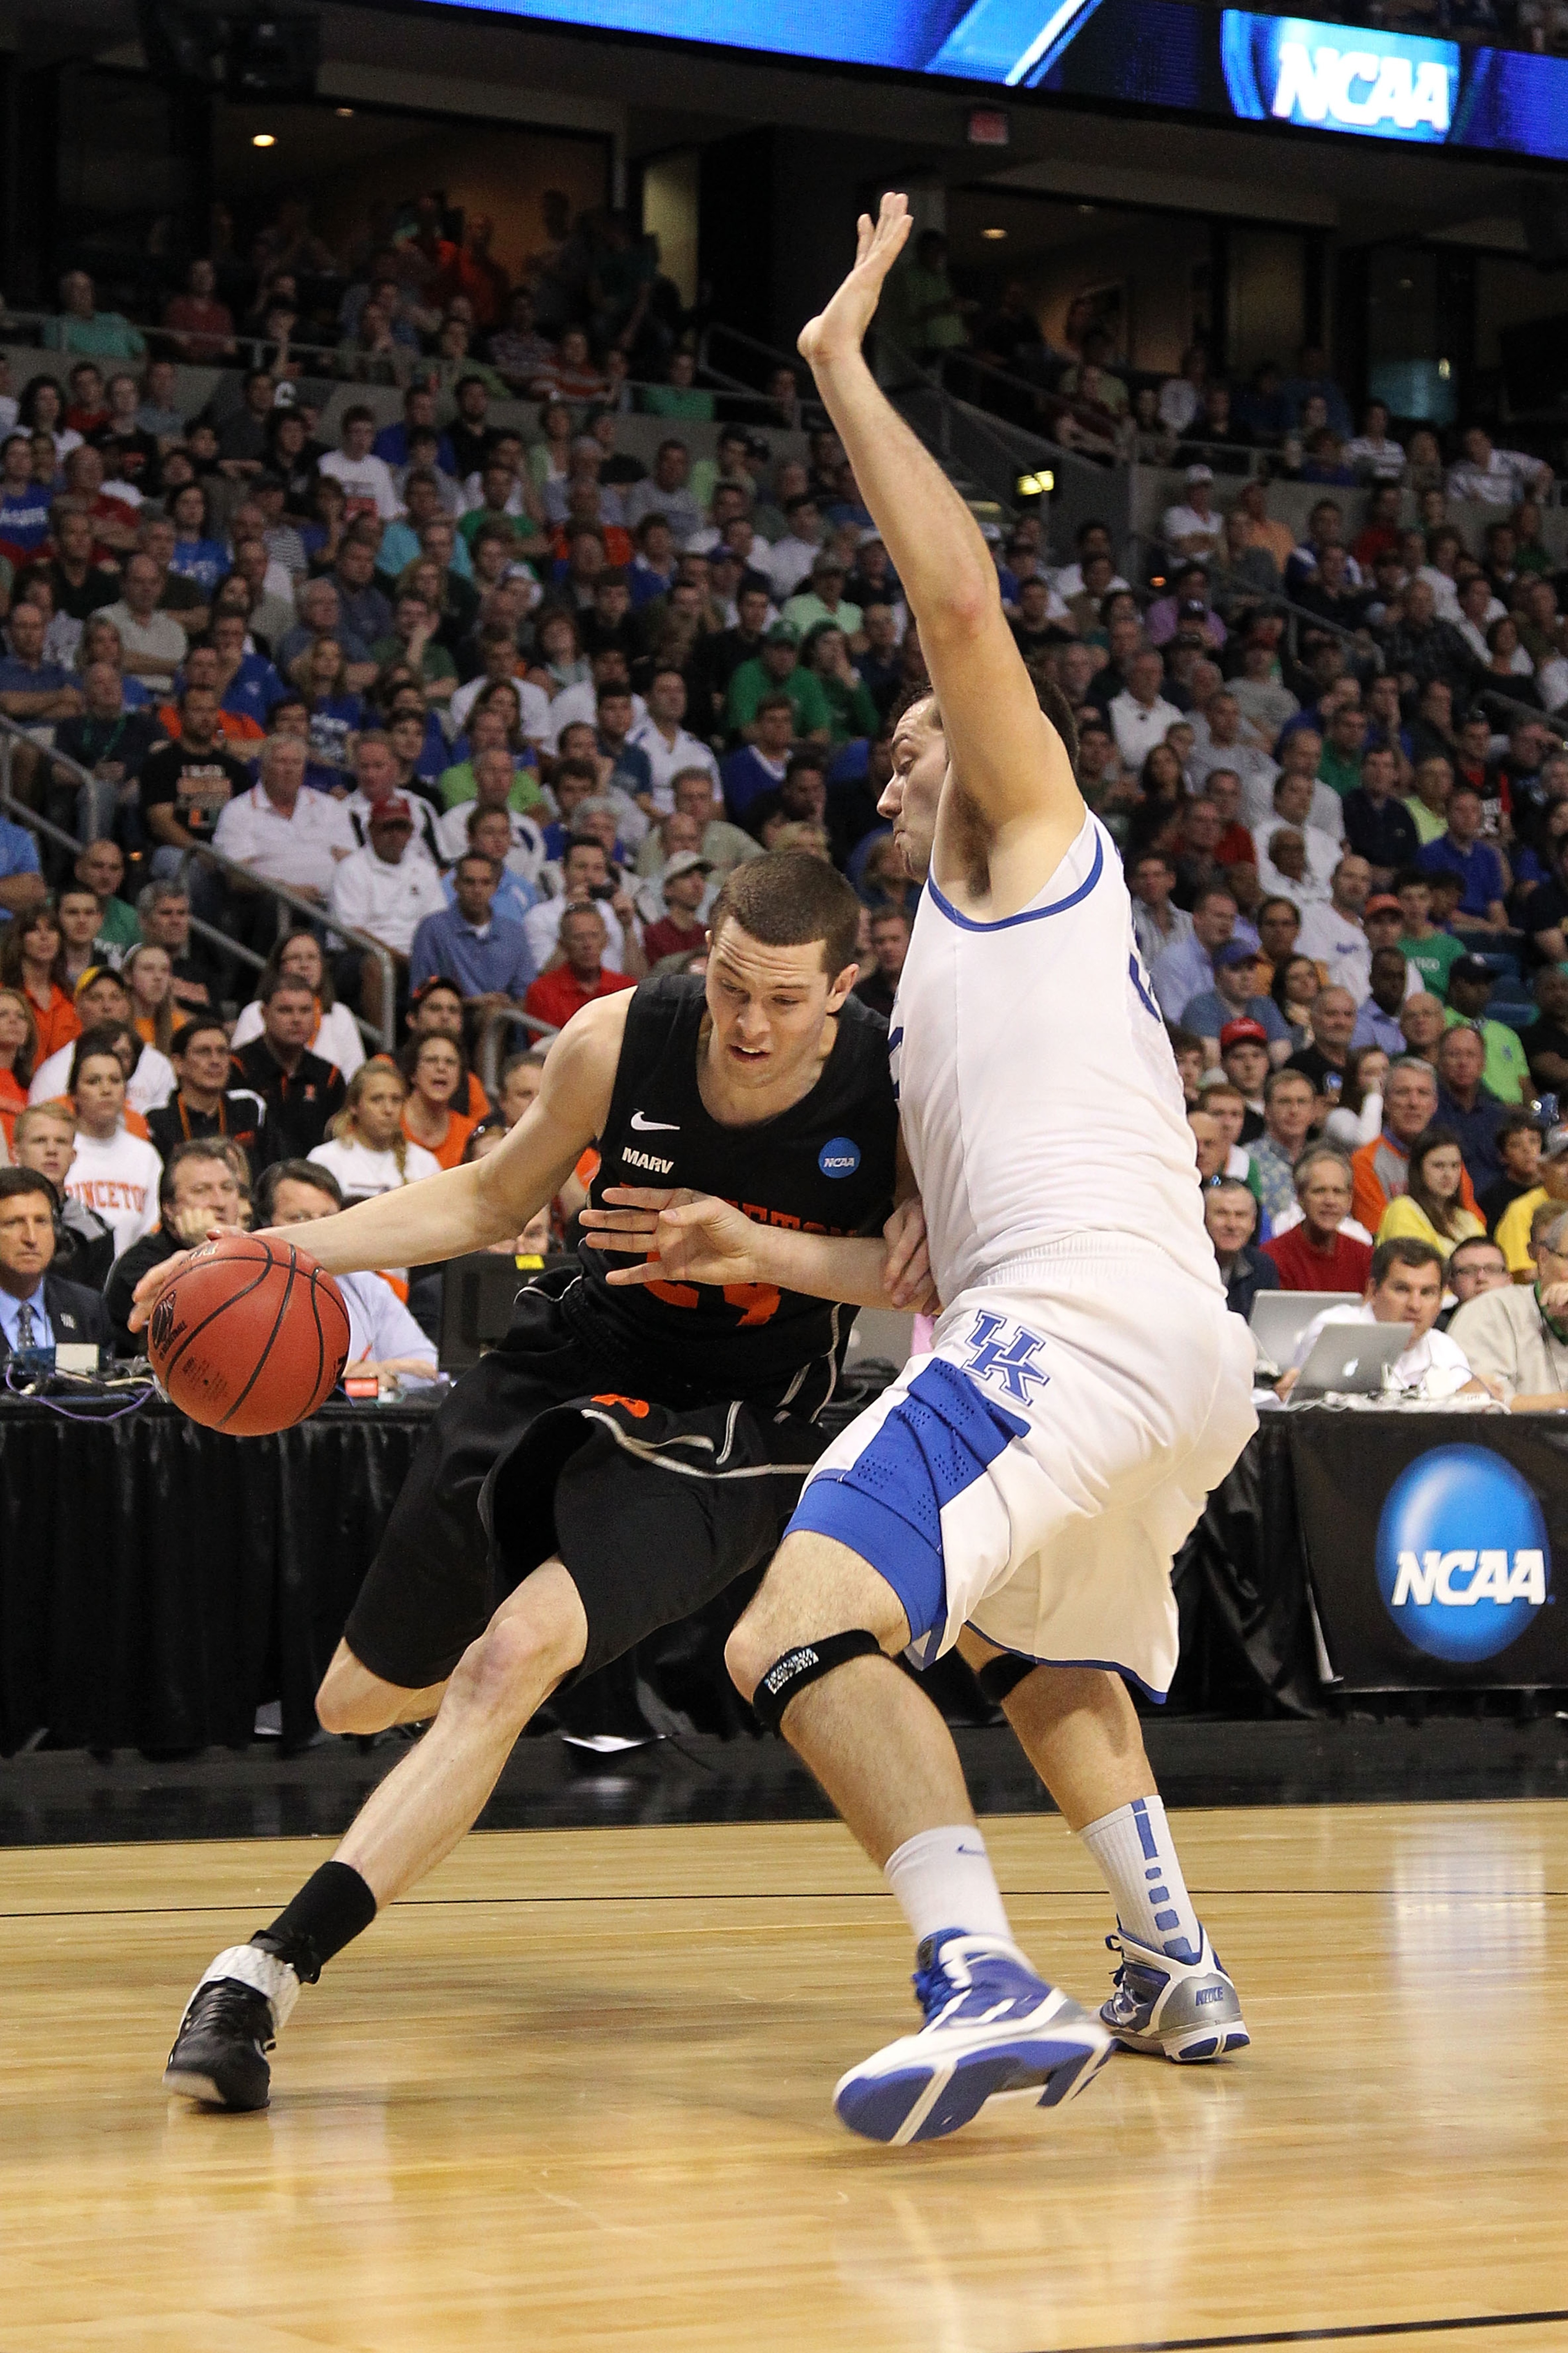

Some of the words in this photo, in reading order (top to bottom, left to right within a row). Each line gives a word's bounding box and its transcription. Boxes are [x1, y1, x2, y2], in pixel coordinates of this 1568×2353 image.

[1273, 42, 1450, 133] NCAA
[621, 1146, 674, 1174] MARV
[823, 1157, 855, 1168] NCAA
[962, 1309, 1052, 1407] UK
[1392, 1550, 1546, 1606] NCAA
[1196, 1987, 1223, 2007] NIKE
